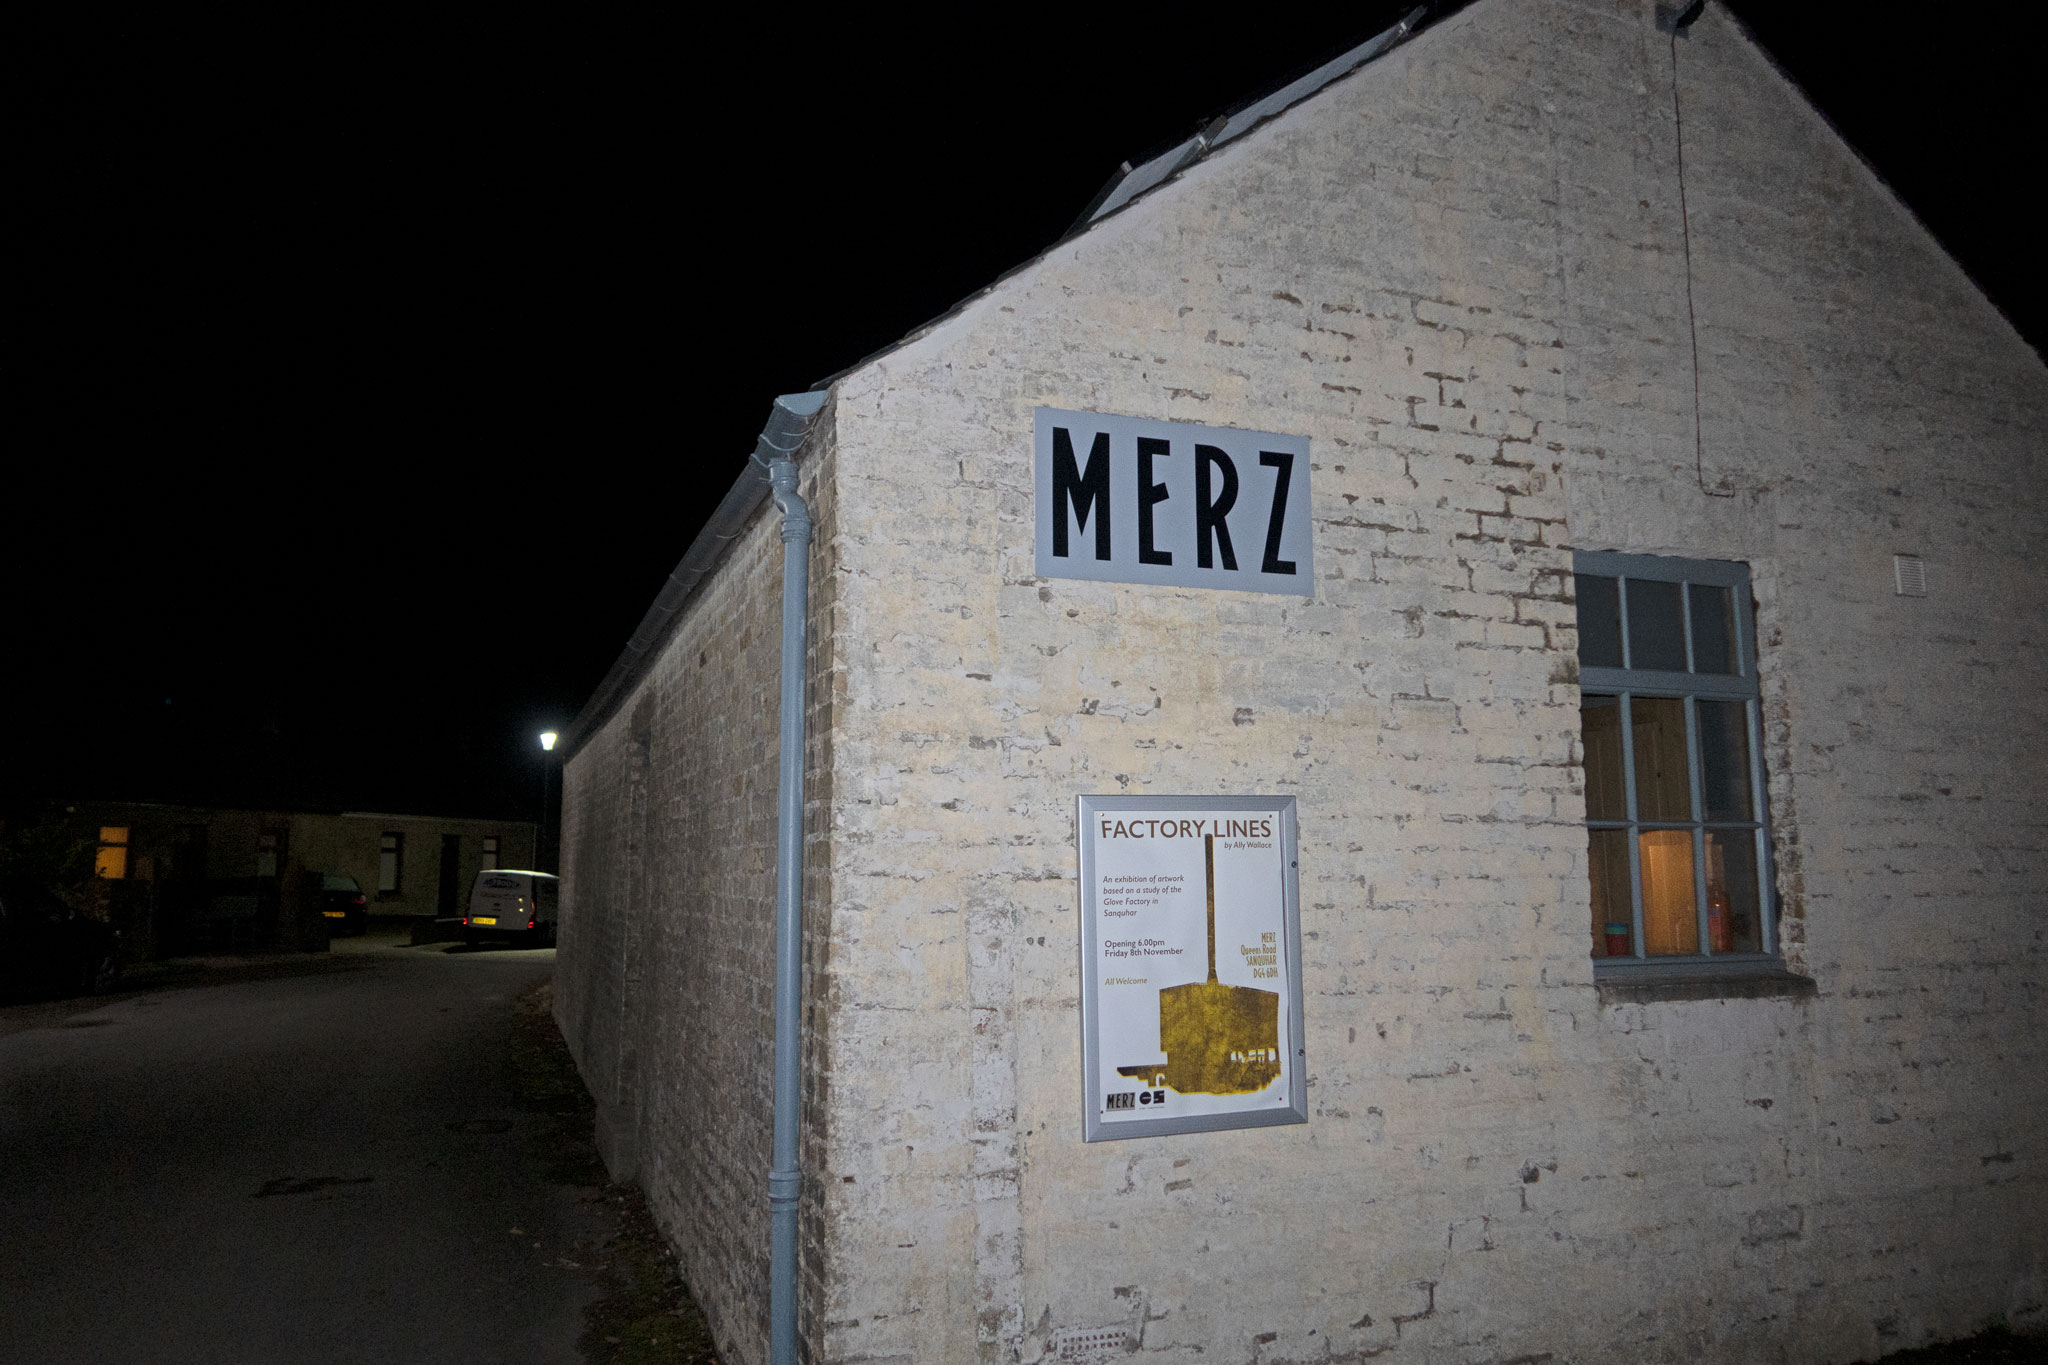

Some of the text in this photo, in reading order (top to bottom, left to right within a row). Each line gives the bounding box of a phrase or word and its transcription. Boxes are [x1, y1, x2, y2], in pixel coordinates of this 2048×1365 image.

[1053, 427, 1296, 575] MERZ
[1101, 820, 1271, 838] FACTORY LINES
[1224, 842, 1232, 850] by
[1233, 842, 1245, 850] Ally
[1115, 875, 1147, 883] exhibition
[1149, 875, 1157, 883] of
[1143, 887, 1160, 895] study
[1162, 886, 1169, 894] of
[1125, 898, 1150, 906] Factory
[1104, 909, 1137, 918] Sanquhar
[1261, 932, 1276, 943] MERZ
[1104, 939, 1165, 949] Opening 6.00pm
[1262, 943, 1277, 953] Road
[1105, 949, 1128, 958] Friday
[1144, 948, 1183, 956] November
[1246, 955, 1277, 966] SANQUHAR
[1116, 977, 1147, 985] Welcome
[1107, 1092, 1135, 1109] MERZ
